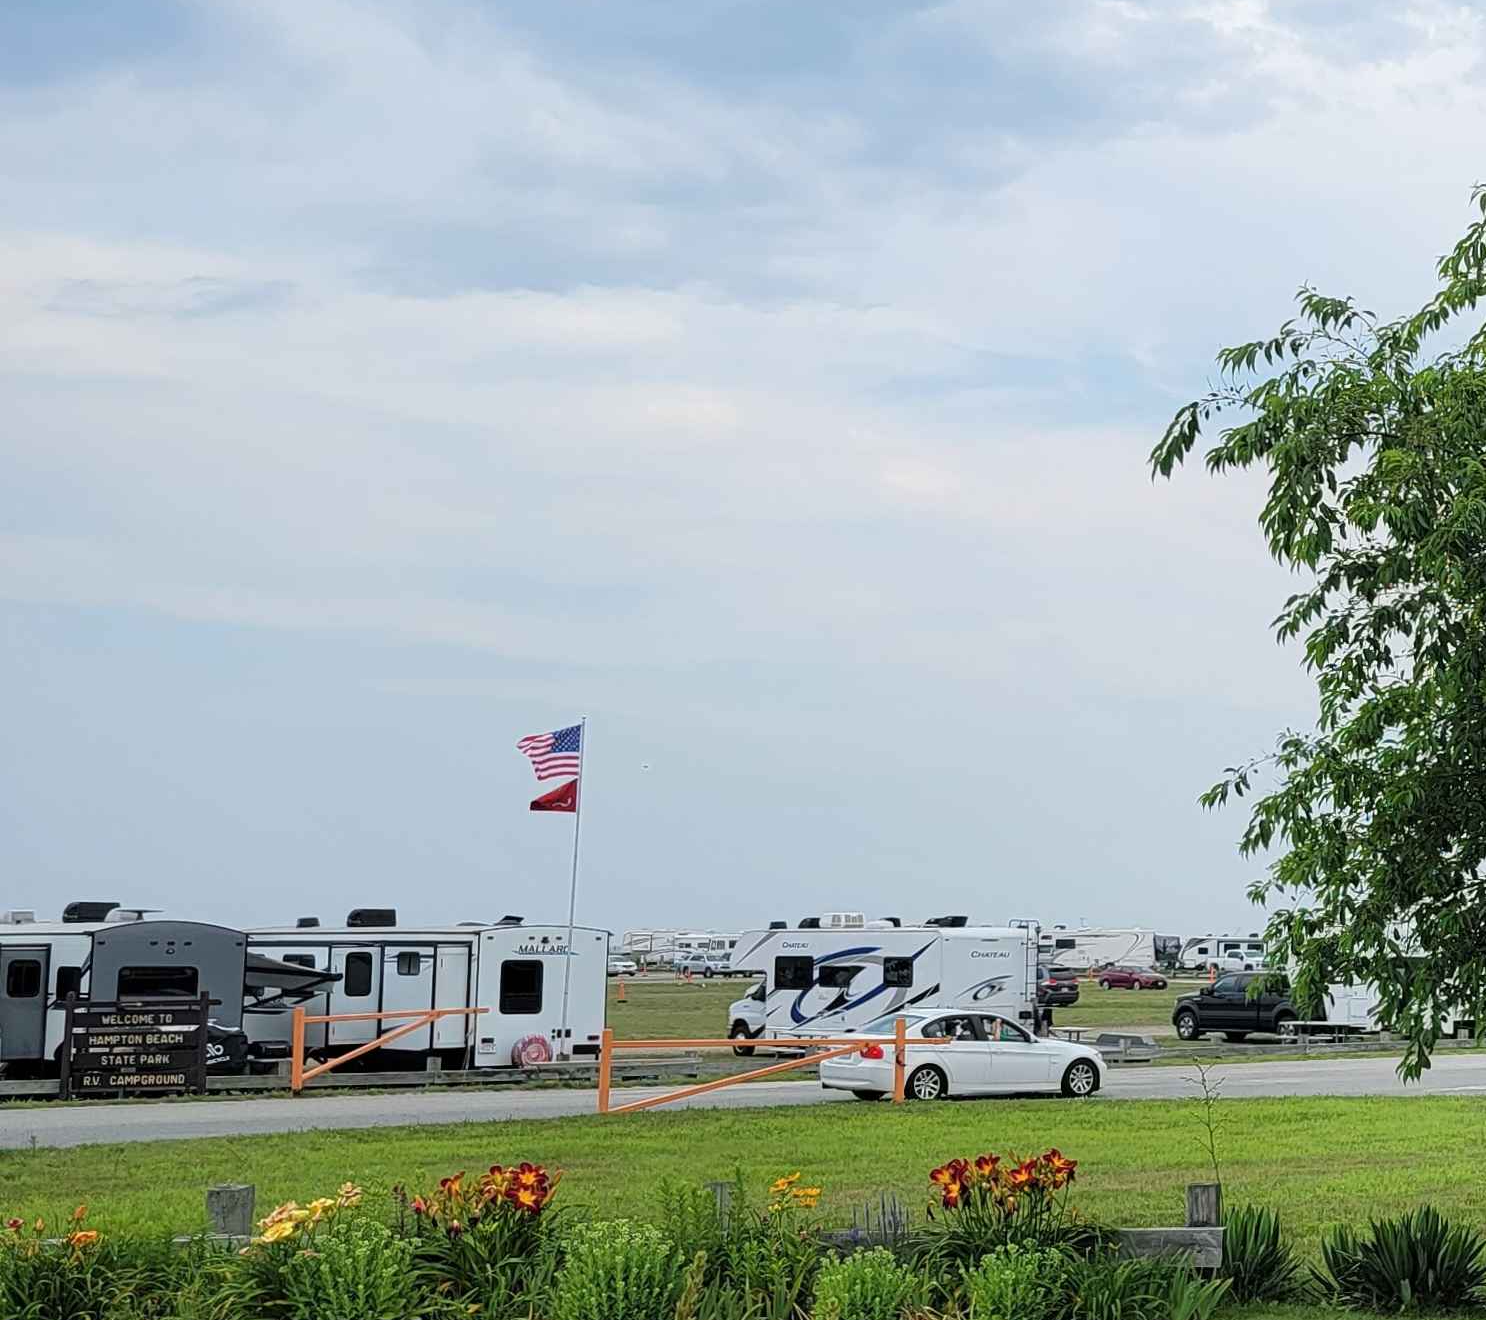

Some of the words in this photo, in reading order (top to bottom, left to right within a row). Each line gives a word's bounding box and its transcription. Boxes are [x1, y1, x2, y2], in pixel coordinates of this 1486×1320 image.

[102, 1014, 155, 1025] WELCOME
[159, 1014, 172, 1024] TO
[88, 1035, 143, 1046] HAMPTON
[145, 1034, 184, 1045] BEACH
[101, 1055, 136, 1066] STATE
[140, 1054, 171, 1065] PARK
[110, 1074, 185, 1086] CAMPGROUND
